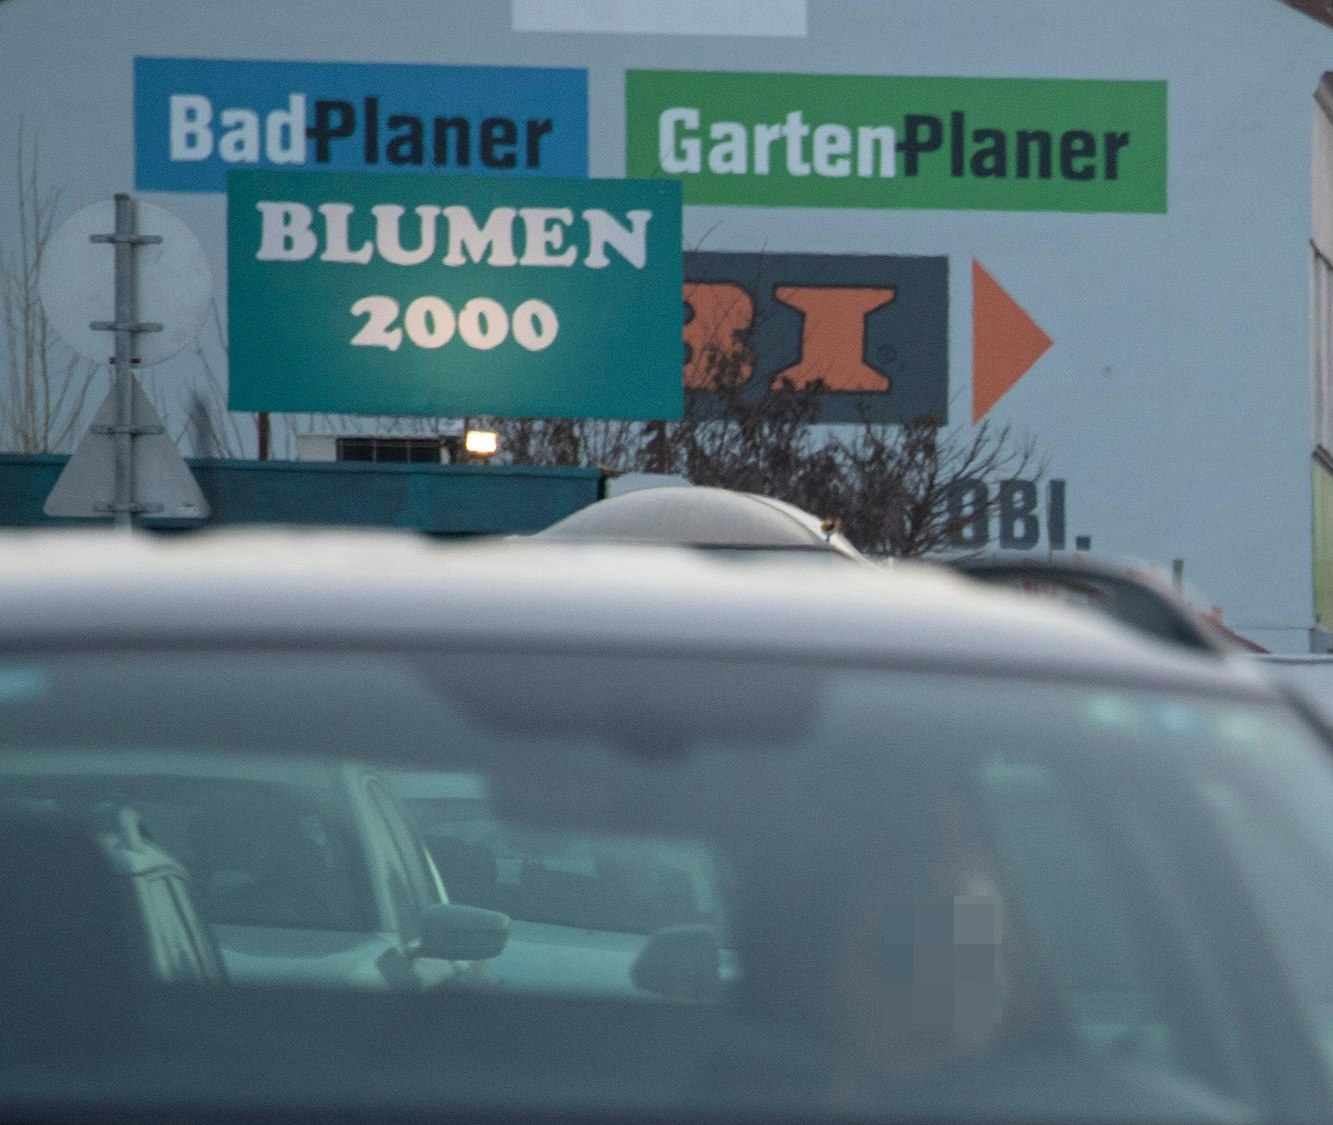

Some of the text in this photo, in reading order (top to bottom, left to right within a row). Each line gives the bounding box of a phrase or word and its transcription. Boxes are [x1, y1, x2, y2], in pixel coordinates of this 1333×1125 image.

[169, 93, 553, 169] BadPlaner
[657, 106, 1130, 181] GartenPlaner
[256, 201, 653, 270] BLUMEN
[350, 295, 559, 352] 2000
